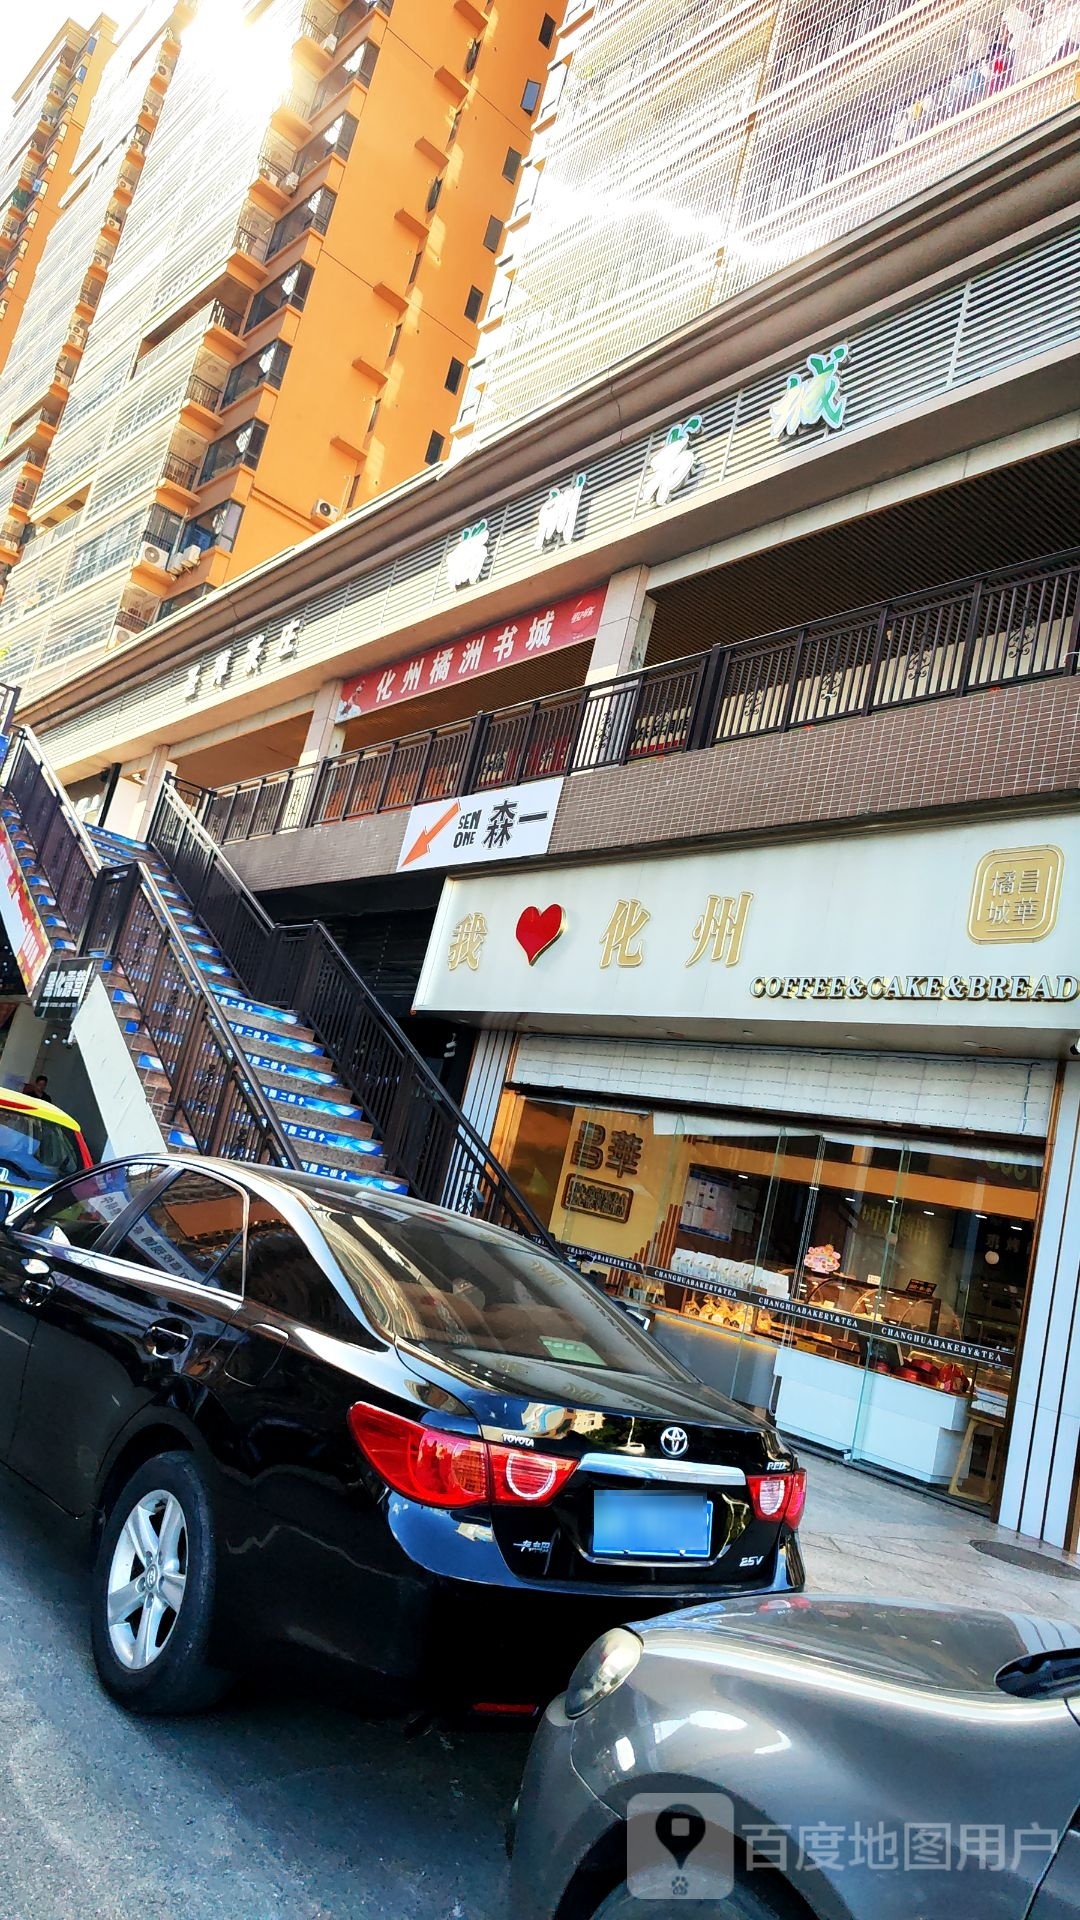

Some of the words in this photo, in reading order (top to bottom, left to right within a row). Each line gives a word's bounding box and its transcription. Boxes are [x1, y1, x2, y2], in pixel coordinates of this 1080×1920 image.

[375, 600, 556, 704] 化州橘洲书城
[458, 809, 482, 830] SEN
[482, 799, 549, 850] 森一
[453, 831, 476, 849] ONE
[447, 911, 488, 972] 我
[600, 892, 756, 969] 化州
[749, 974, 1080, 1002] COFFEE&CAKE&BREAD
[570, 1120, 644, 1179] 昌華
[758, 1296, 859, 1328] CHANGHUABAKERY&TEA
[881, 1326, 1002, 1362] CHANGHUABAKERY&TEA
[502, 1433, 535, 1448] TOYOTA
